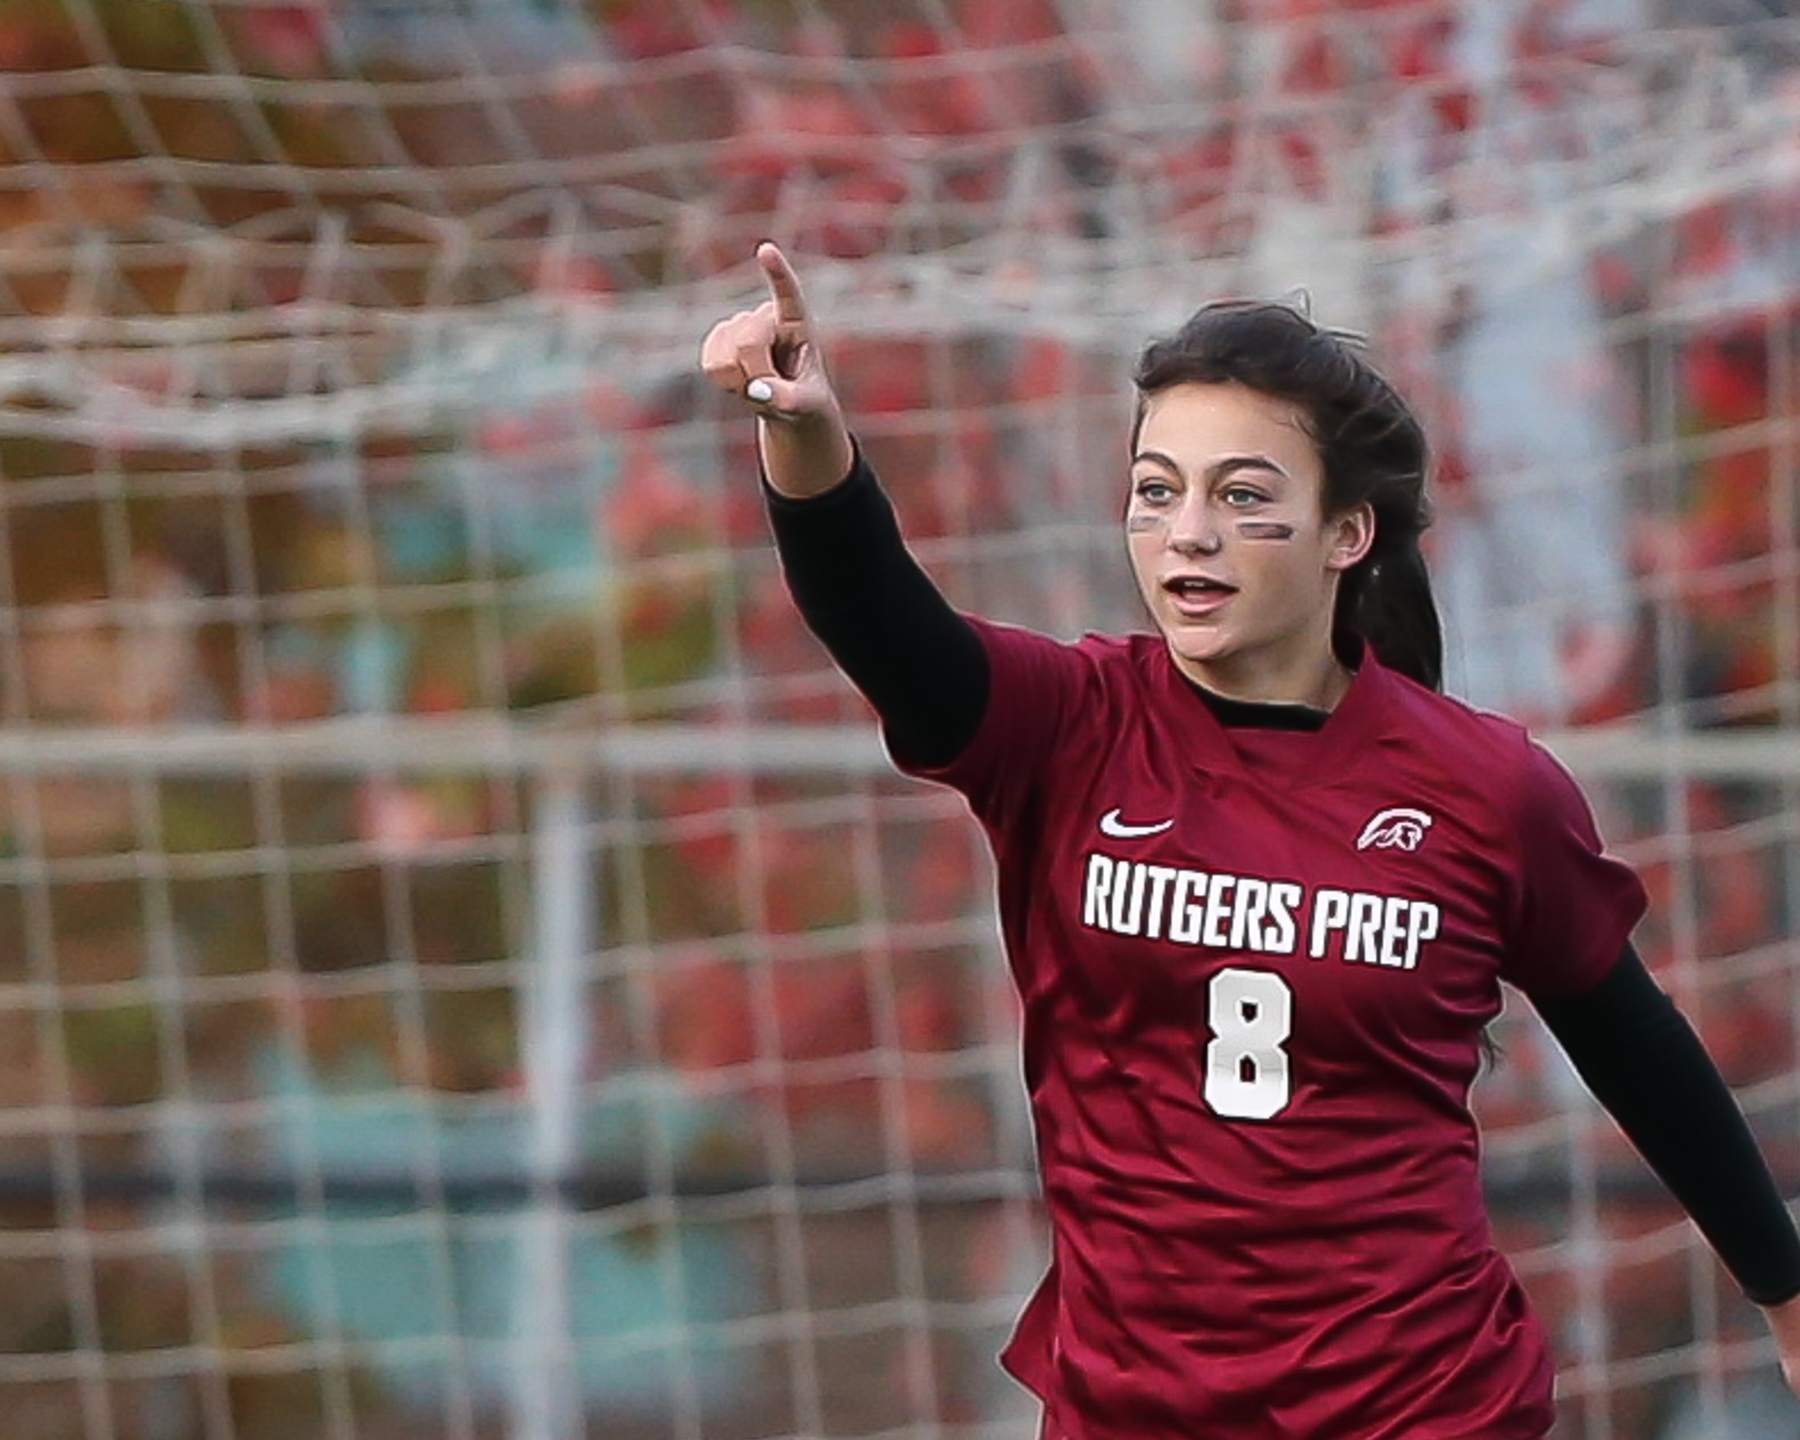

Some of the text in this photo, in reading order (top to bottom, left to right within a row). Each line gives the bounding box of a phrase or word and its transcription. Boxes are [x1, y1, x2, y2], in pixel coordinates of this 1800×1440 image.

[1084, 855, 1439, 968] RUTGERS PREP
[1204, 968, 1291, 1118] 8
